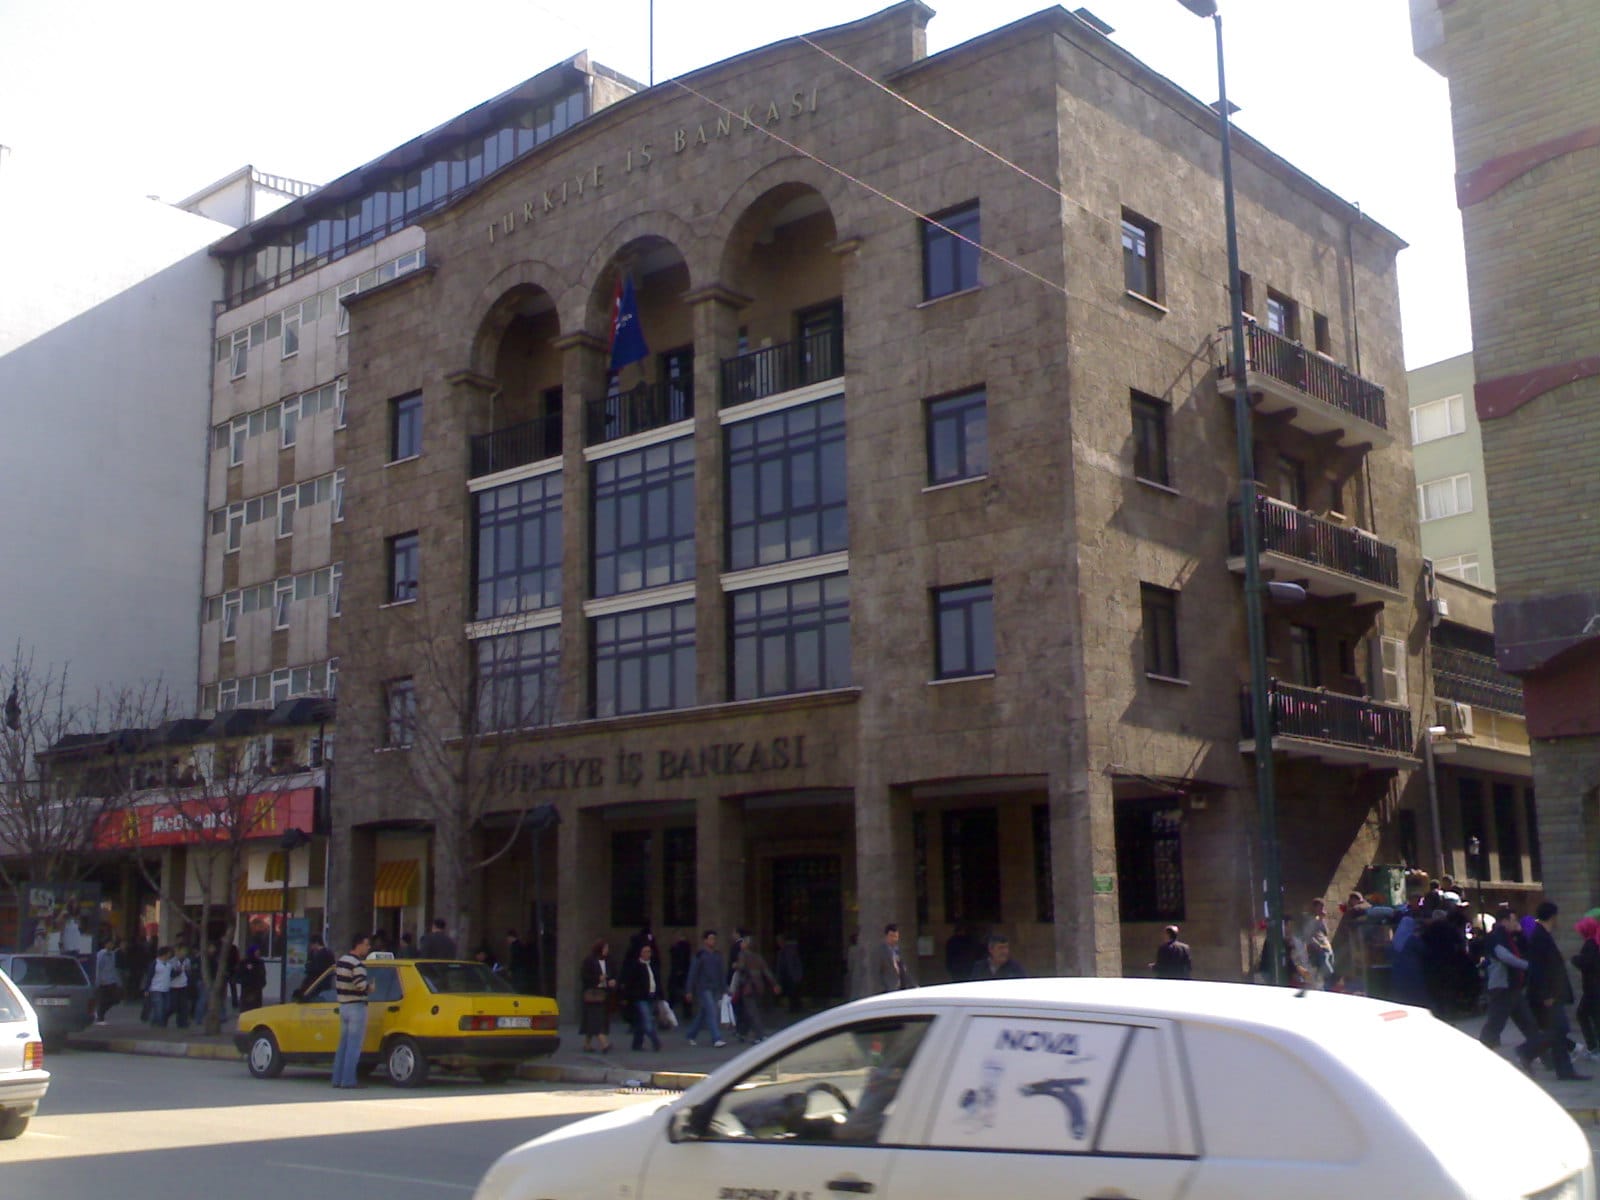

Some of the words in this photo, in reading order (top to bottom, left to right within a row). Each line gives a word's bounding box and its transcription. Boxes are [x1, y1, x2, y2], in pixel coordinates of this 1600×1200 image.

[673, 87, 818, 153] BANKASI
[658, 735, 807, 781] BANKASI
[996, 1029, 1079, 1056] NOVA
